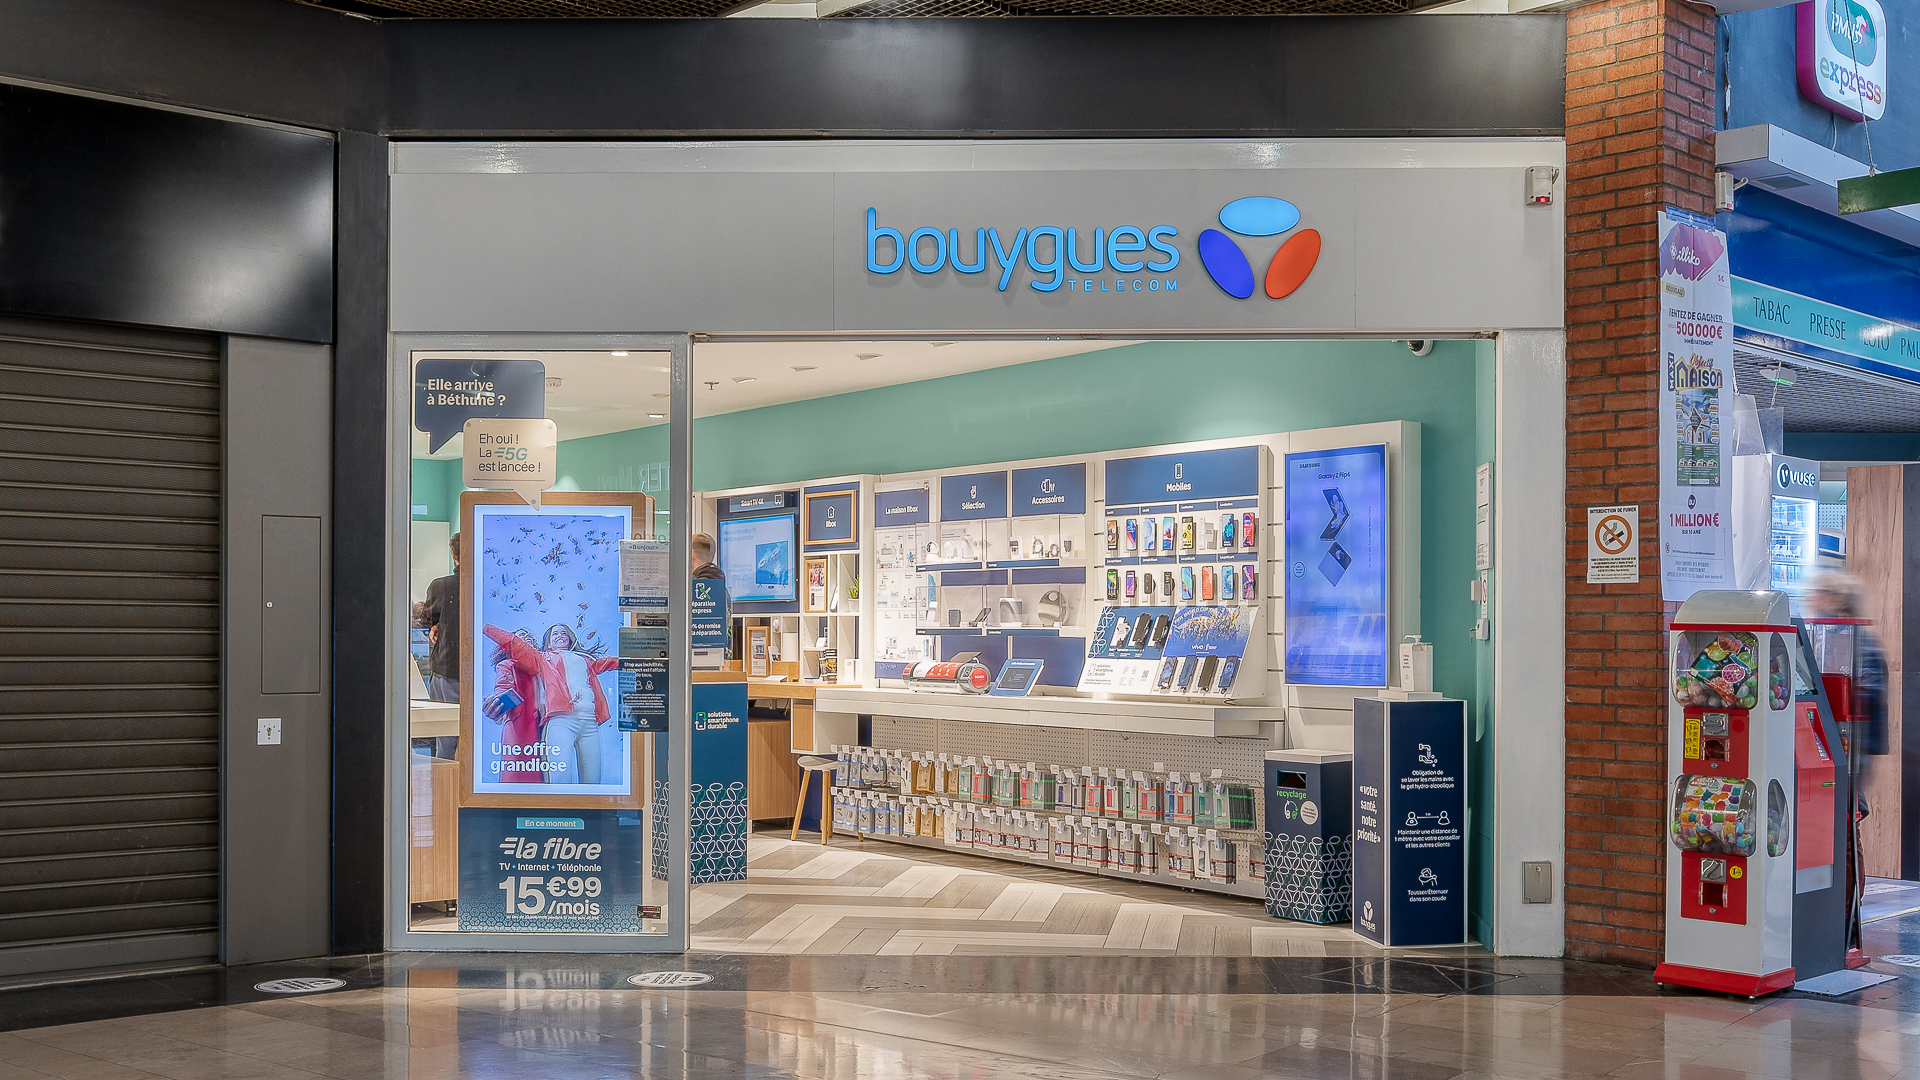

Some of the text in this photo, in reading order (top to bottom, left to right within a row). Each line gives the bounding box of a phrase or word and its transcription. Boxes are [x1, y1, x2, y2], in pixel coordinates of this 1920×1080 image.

[1820, 56, 1882, 105] express
[866, 206, 1180, 292] bouygues
[1068, 279, 1178, 292] TELECOM
[1665, 284, 1683, 296] NOUVEAU
[1668, 308, 1687, 320] TENTEZ
[1687, 311, 1696, 321] DE
[1753, 296, 1791, 325] TABAC
[1809, 312, 1846, 341] PRESSE
[427, 378, 494, 391] Elle arrive
[427, 393, 506, 406] à Béthune ?
[479, 433, 494, 444] Eh
[496, 433, 513, 444] oui
[479, 447, 528, 461] La 5G
[478, 462, 496, 472] est
[498, 460, 535, 472] lancée
[1318, 472, 1336, 480] Galaxy
[1790, 470, 1816, 487] vuse
[1165, 481, 1192, 492] Mobiles
[961, 501, 986, 511] Sélection
[1031, 494, 1065, 506] Accessoires
[1669, 513, 1674, 527] 1
[692, 600, 716, 608] éparation
[491, 742, 561, 756] Une offre
[491, 758, 567, 774] grandiose
[1276, 790, 1307, 801] recyclage
[1359, 785, 1378, 798] «votre
[1360, 799, 1378, 815] santé,
[524, 819, 535, 827] En
[545, 820, 576, 828] moment
[1361, 814, 1377, 828] notre
[1356, 828, 1381, 844] priorité»
[515, 837, 602, 860] la fibre
[499, 862, 602, 873] TV Internet Téléphonie
[547, 899, 600, 915] /mois
